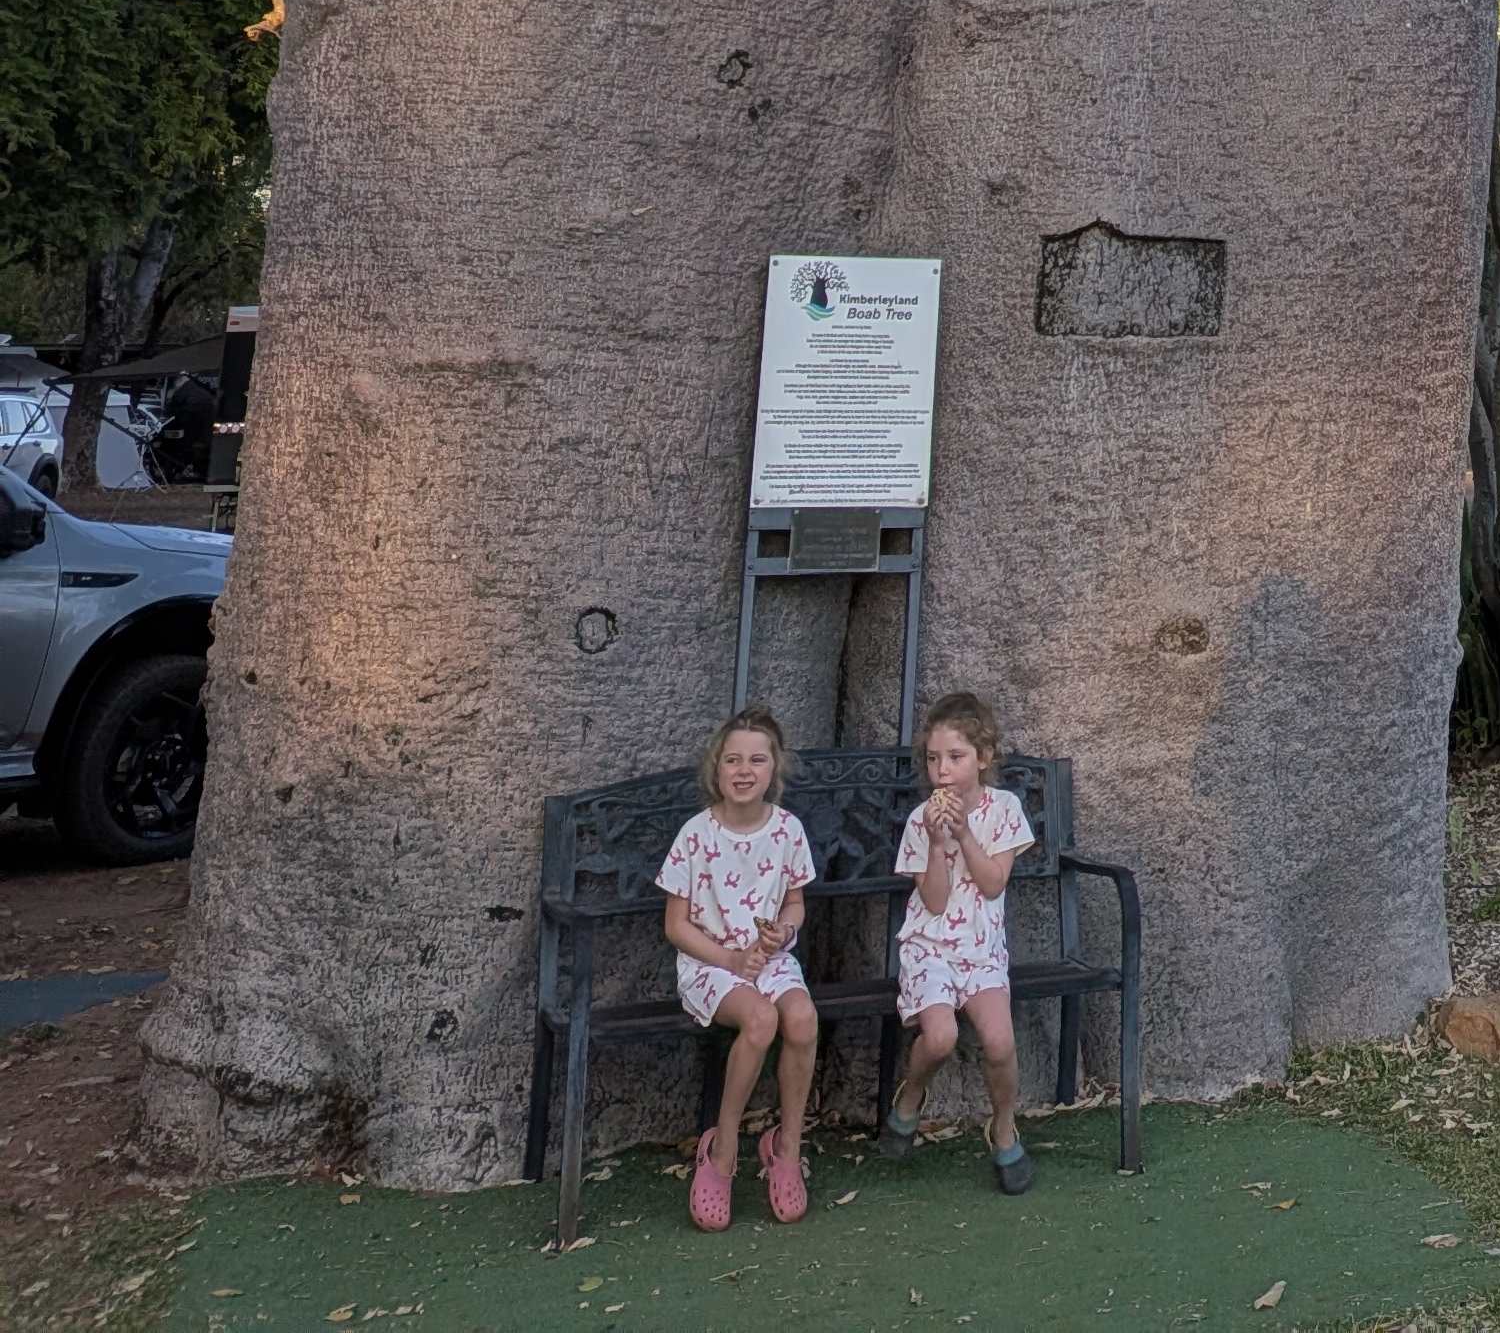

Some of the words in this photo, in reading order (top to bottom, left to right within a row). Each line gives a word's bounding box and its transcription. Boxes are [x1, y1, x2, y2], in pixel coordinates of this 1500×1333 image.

[839, 294, 919, 308] Kimberleyland
[846, 307, 881, 320] Boab
[885, 308, 913, 321] Tree
